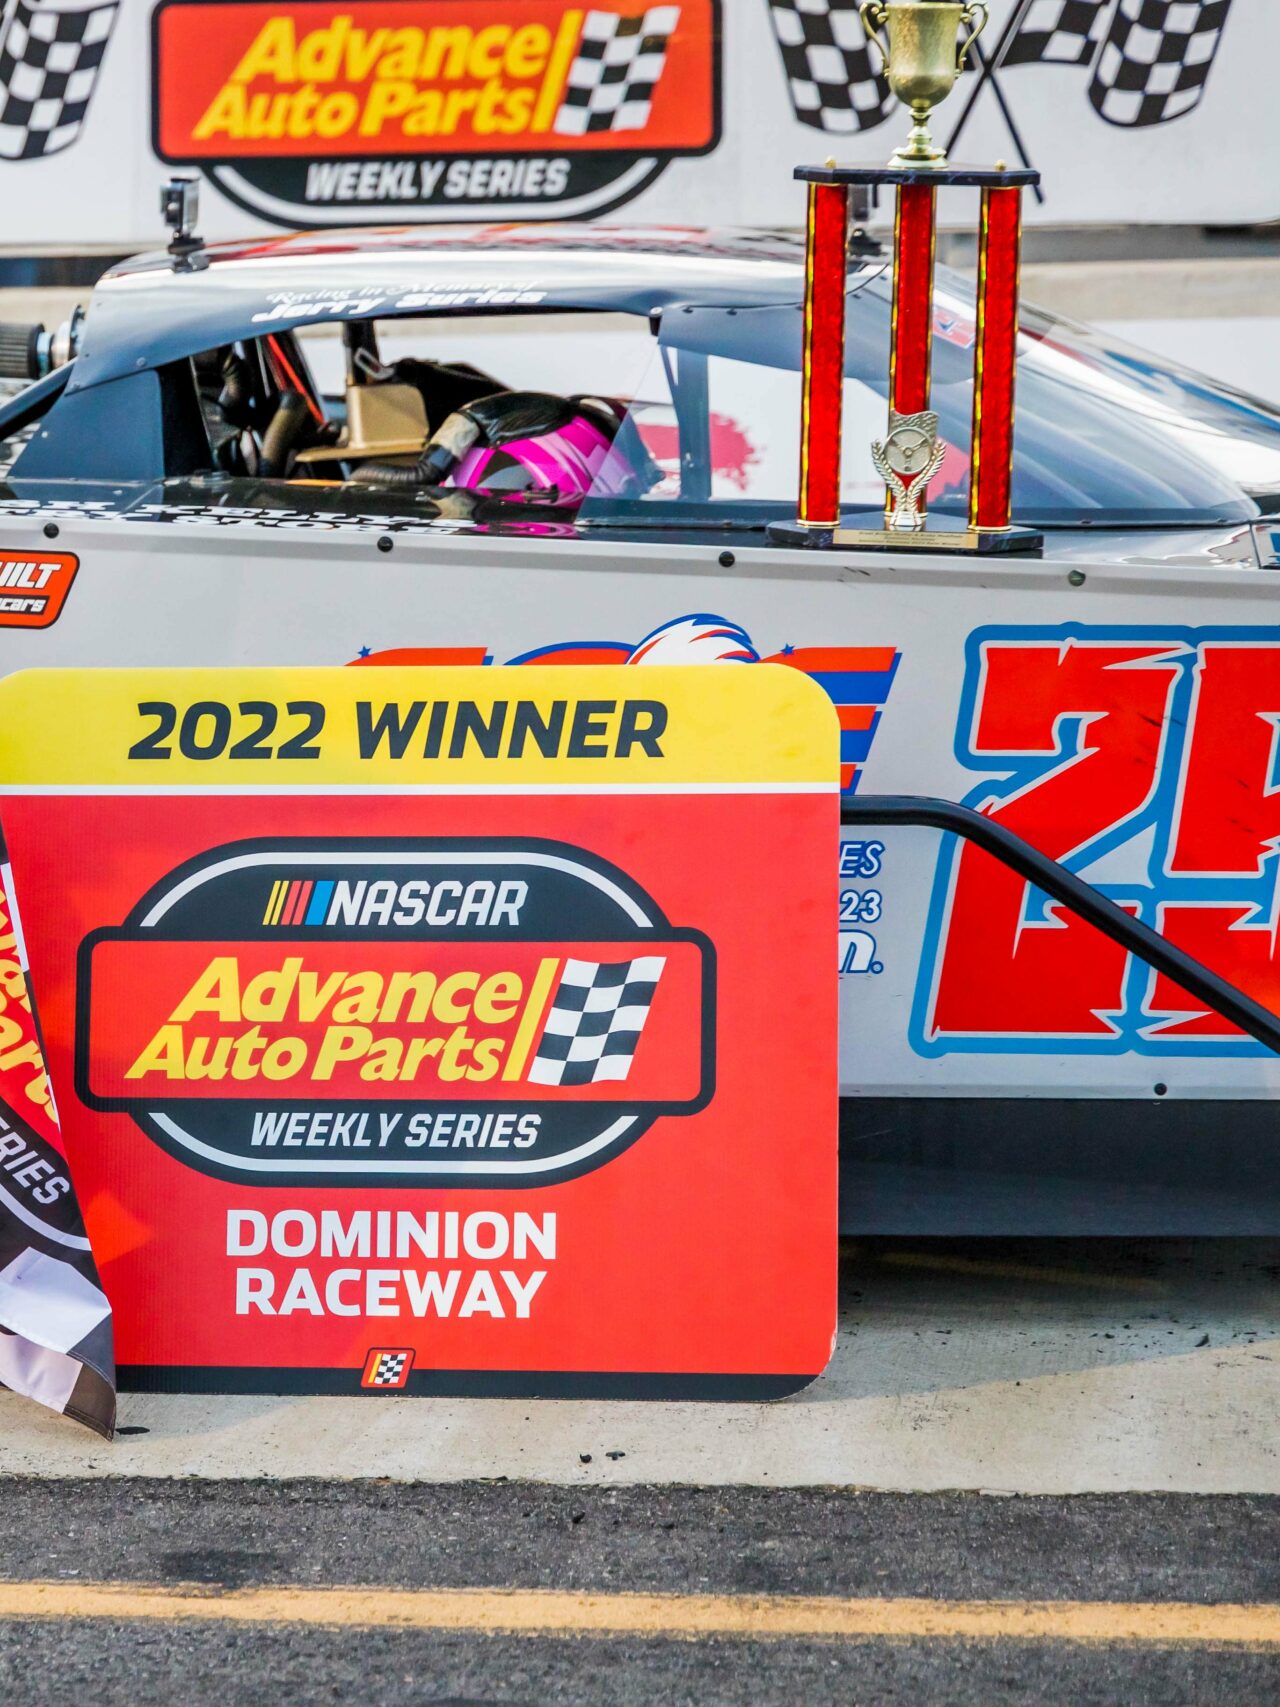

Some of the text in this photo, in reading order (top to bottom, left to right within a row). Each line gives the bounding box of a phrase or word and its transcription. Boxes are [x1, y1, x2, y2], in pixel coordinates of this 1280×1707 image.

[230, 16, 547, 84] Advance
[191, 73, 536, 141] Auto Parts
[306, 158, 571, 202] WEEKLY SERIES
[250, 290, 548, 323] Jerry Surles
[172, 514, 461, 535] STORE
[127, 699, 670, 761] 2022 WINNER
[326, 879, 530, 928] NASCAR
[166, 955, 524, 1025] Advance
[124, 1024, 504, 1083] Auto Parts
[250, 1111, 543, 1149] WEEKLY SERIES
[225, 1208, 558, 1261] DOMINION
[234, 1266, 549, 1320] RACEWAY
